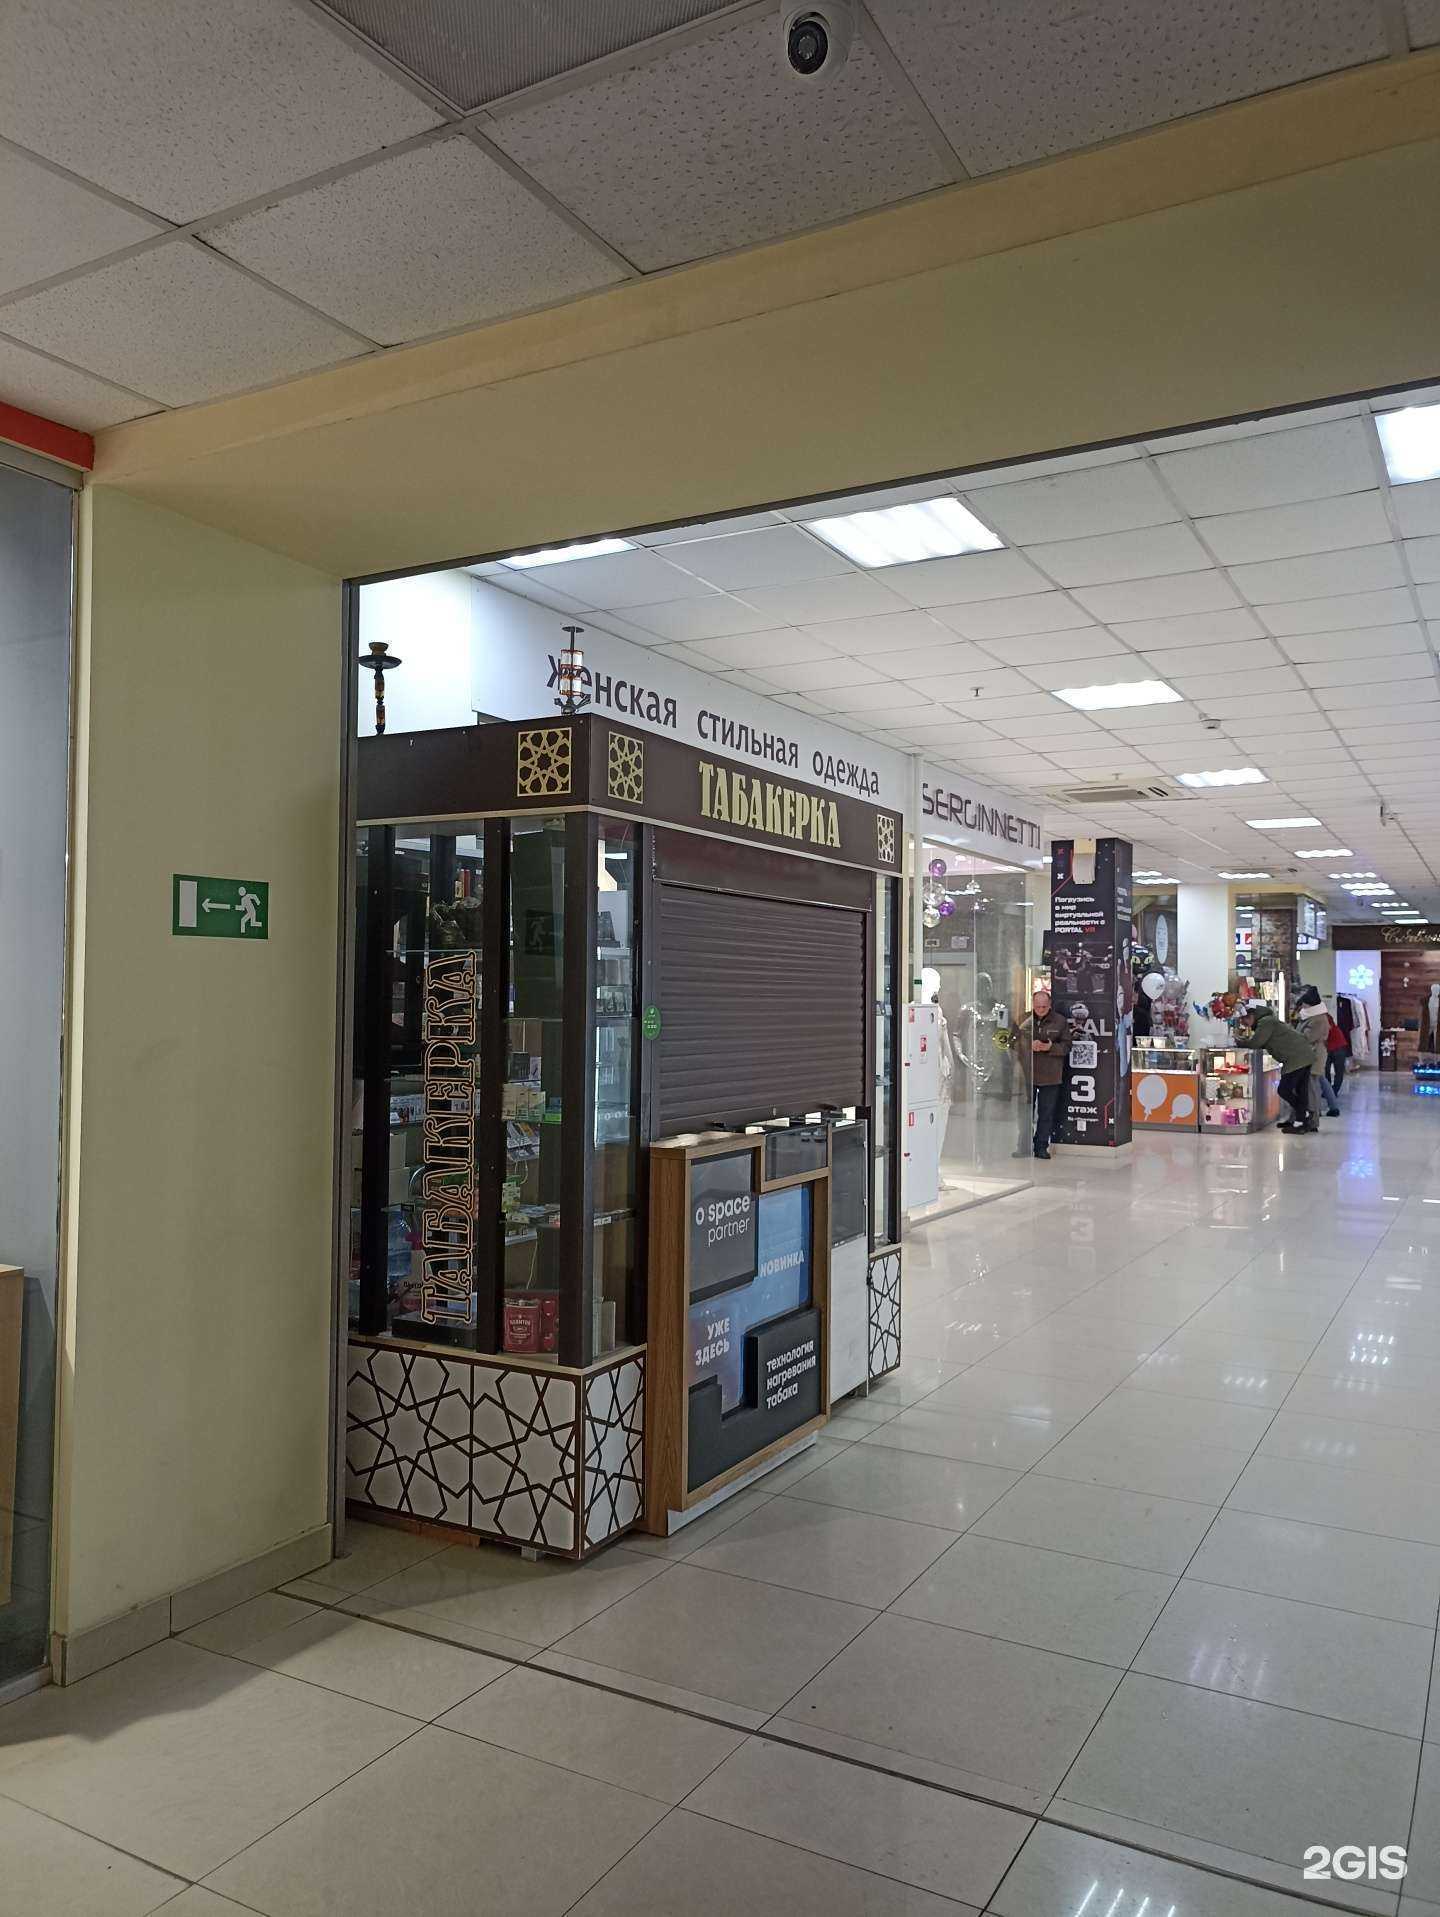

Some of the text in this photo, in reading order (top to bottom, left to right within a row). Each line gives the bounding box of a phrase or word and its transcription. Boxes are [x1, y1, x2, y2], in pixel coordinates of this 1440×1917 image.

[697, 709, 799, 769] стильная
[812, 750, 880, 797] одежда
[699, 760, 841, 848] ТАБАКЕРКА
[1070, 1075, 1096, 1102] 3
[421, 950, 476, 1324] ТАБАКЕРКА
[708, 1195, 750, 1226] space
[708, 1217, 750, 1248] partner
[759, 1249, 805, 1278] НОВИНКА
[707, 1316, 730, 1341] УЖЕ
[695, 1338, 730, 1368] ЗДЕСЬ
[766, 1340, 814, 1373] технология
[766, 1355, 816, 1391] нагревания
[766, 1382, 799, 1409] табака
